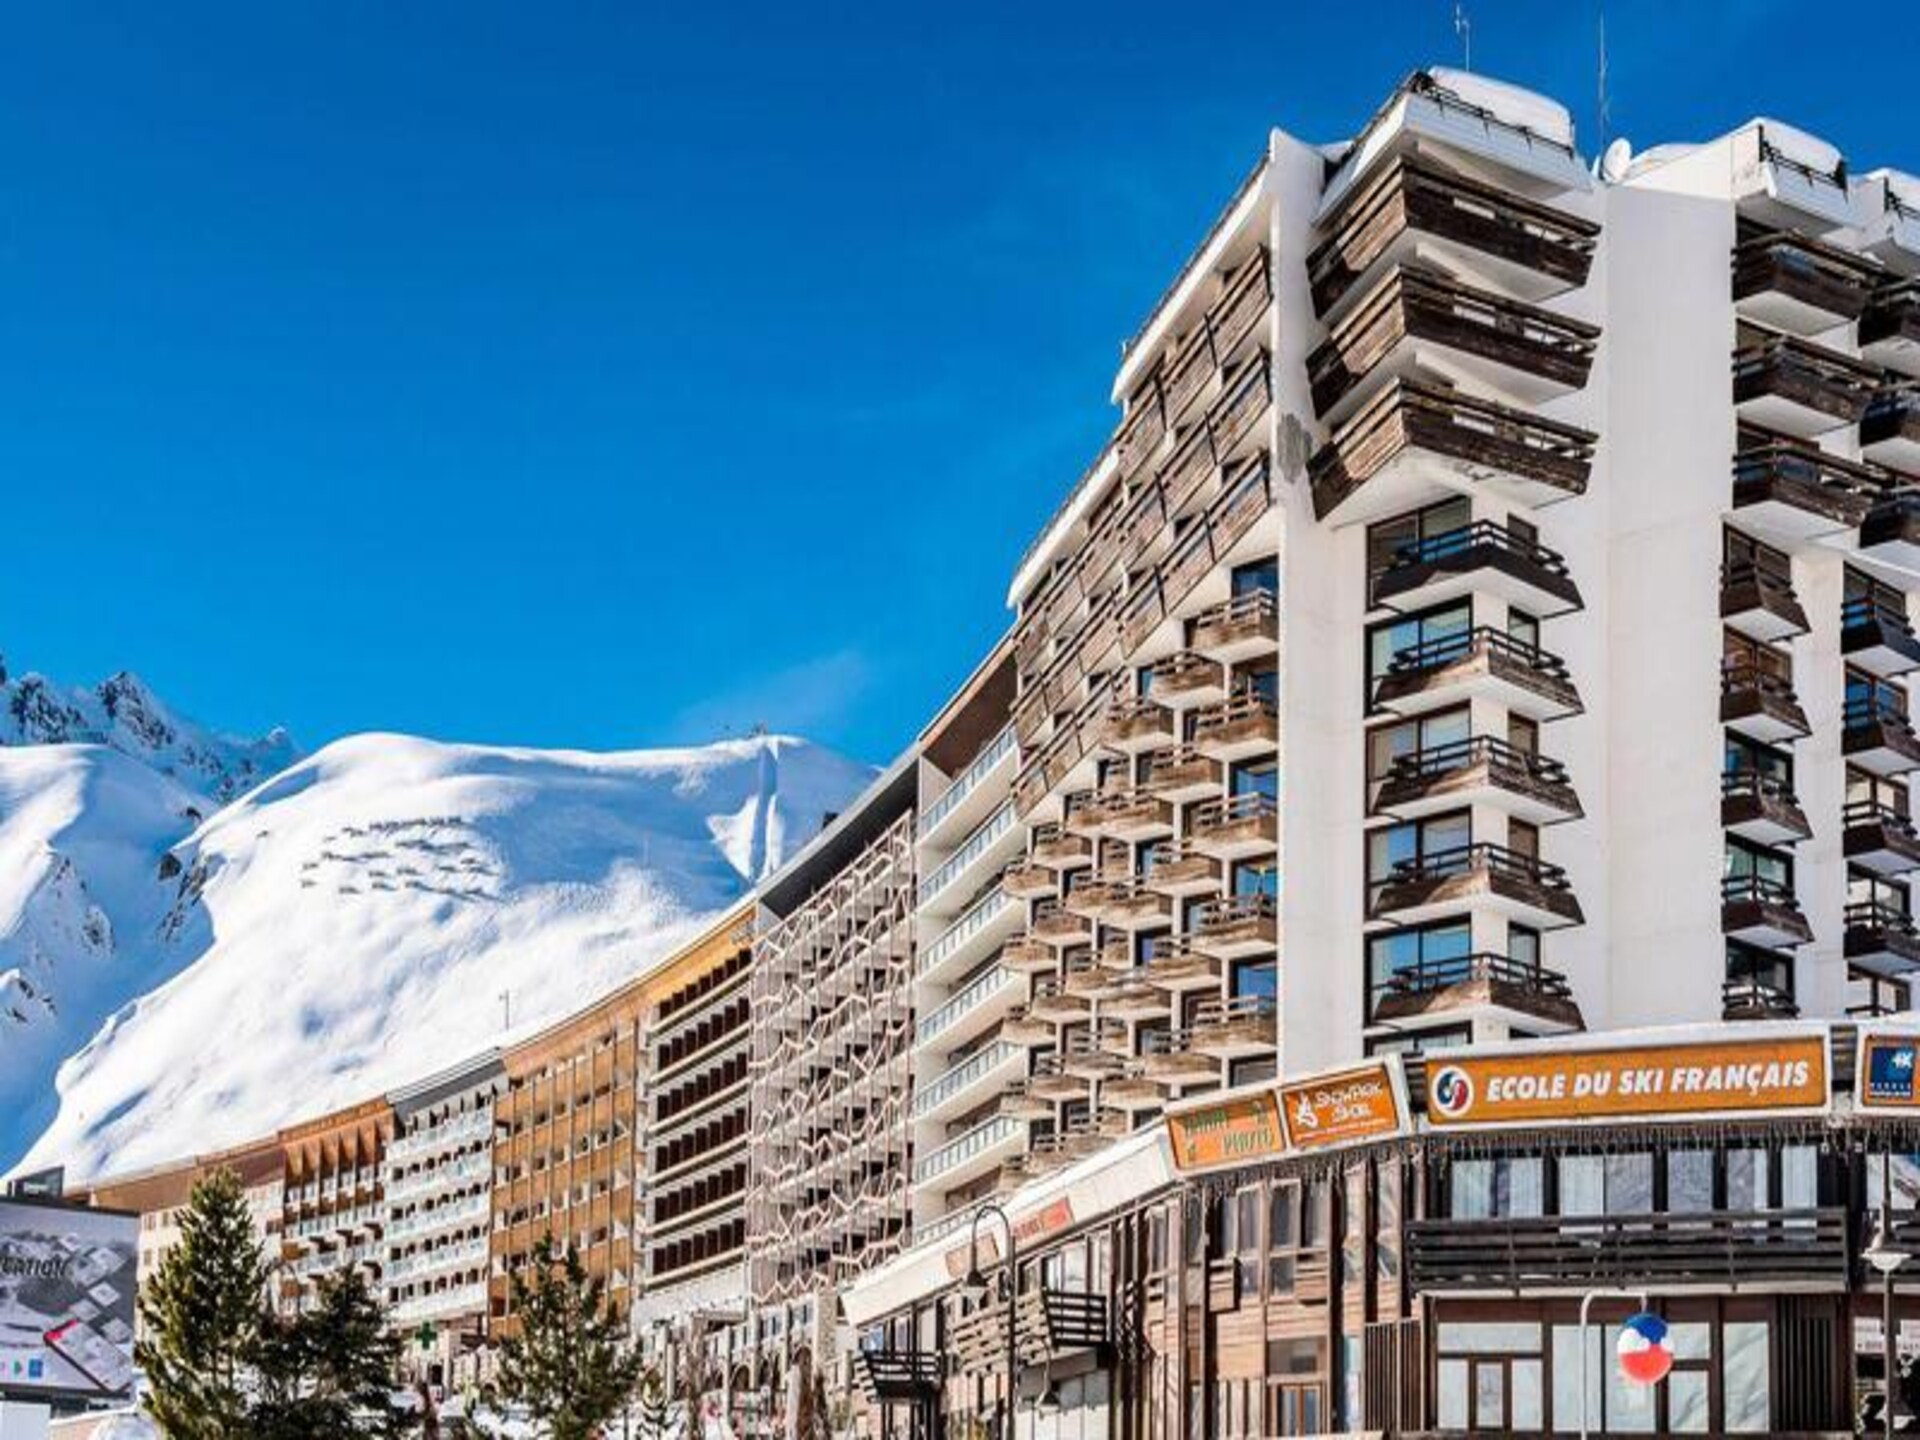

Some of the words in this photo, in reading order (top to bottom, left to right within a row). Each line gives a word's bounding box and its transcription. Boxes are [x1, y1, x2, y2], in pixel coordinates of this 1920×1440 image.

[1485, 1072, 1567, 1102] ECOLE
[1573, 1071, 1611, 1098] DU
[1617, 1069, 1664, 1094] SKI
[1670, 1060, 1809, 1097] FRANÇAIS
